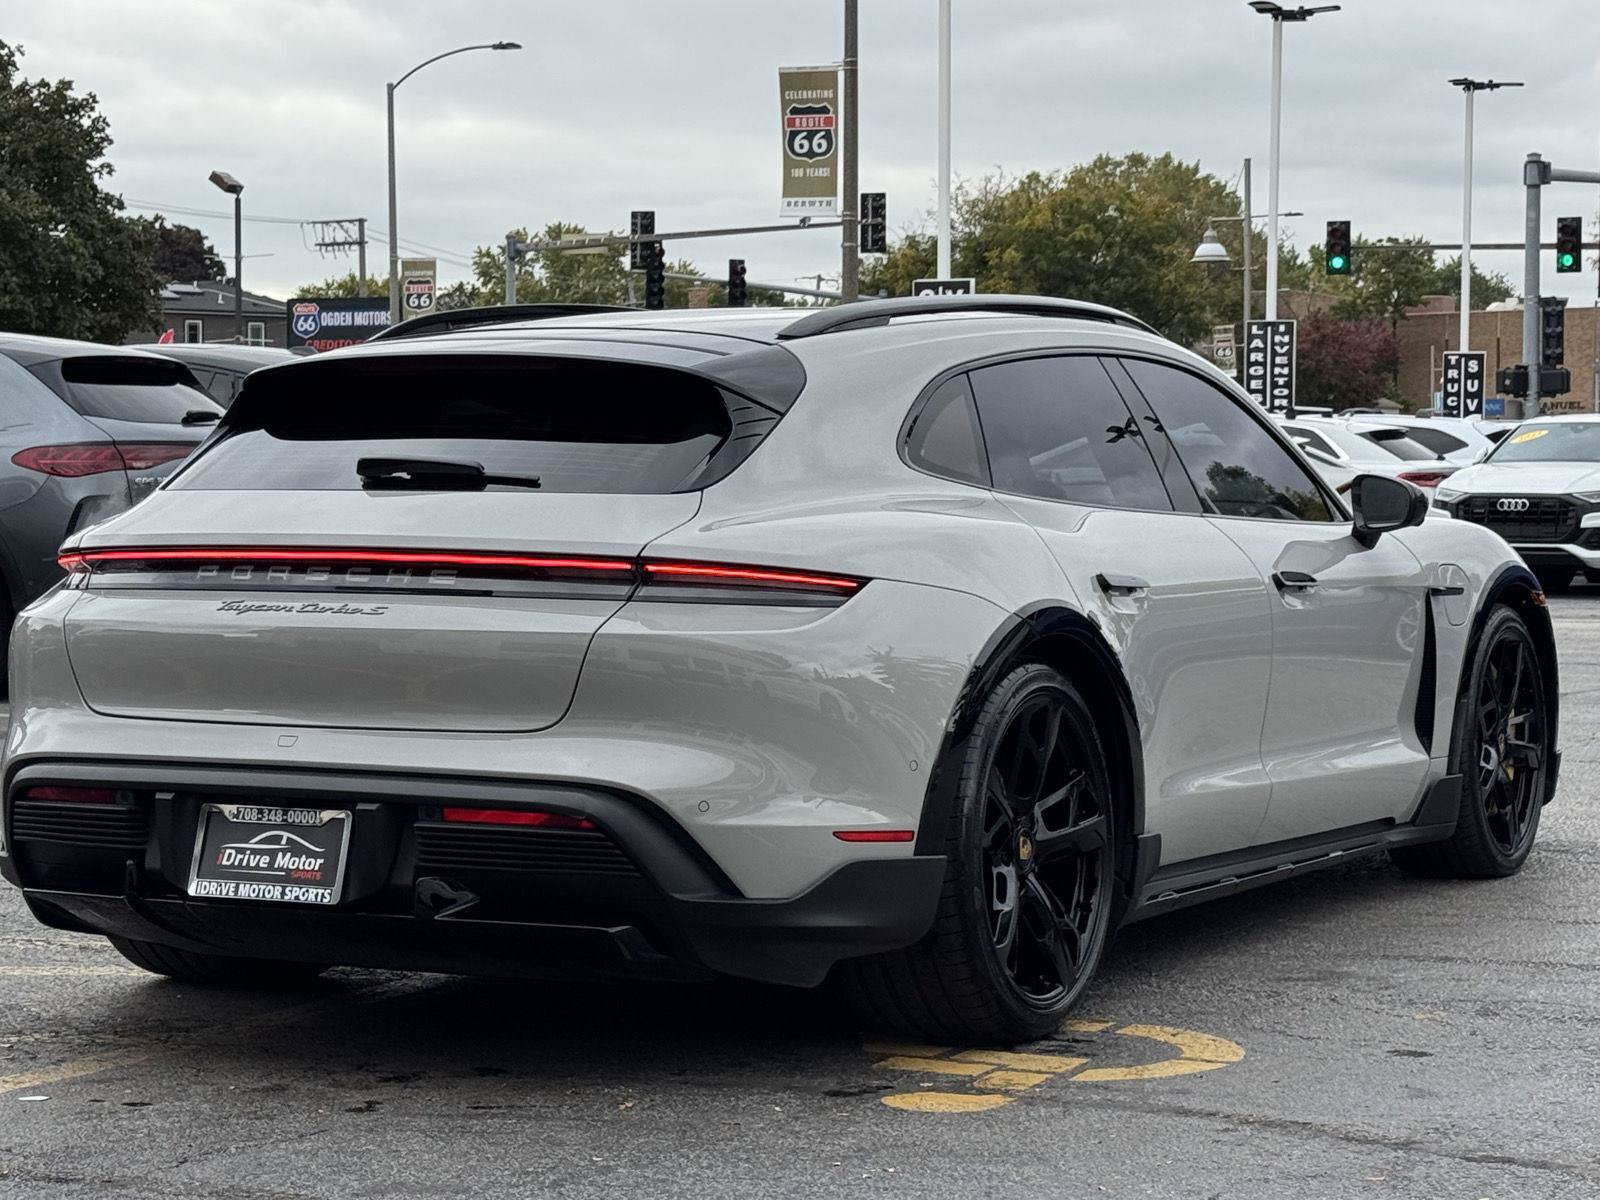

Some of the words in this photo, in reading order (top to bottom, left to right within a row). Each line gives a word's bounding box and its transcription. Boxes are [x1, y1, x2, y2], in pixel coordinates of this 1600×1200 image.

[785, 89, 833, 100] CELEBRATING
[794, 117, 825, 127] ROUTE
[793, 131, 828, 154] 66
[791, 168, 803, 178] 100
[806, 167, 830, 177] YEARS!
[786, 200, 832, 208] BERWYN
[409, 294, 430, 307] 66
[297, 316, 316, 332] 66
[320, 311, 353, 327] OGDEN
[354, 311, 392, 327] MOTORS
[1217, 347, 1232, 357] 66
[1447, 355, 1459, 414] TRUC
[1466, 360, 1479, 412] SUV
[1541, 401, 1585, 410] ANUEL
[196, 565, 457, 585] PORSCHE
[216, 600, 294, 615] Taycan
[238, 807, 315, 824] 708-348-0000
[216, 848, 270, 868] iDrive
[274, 851, 324, 871] Motor
[290, 870, 322, 880] SPORTS
[237, 883, 283, 900] MOTOR
[284, 886, 332, 903] SPORTS
